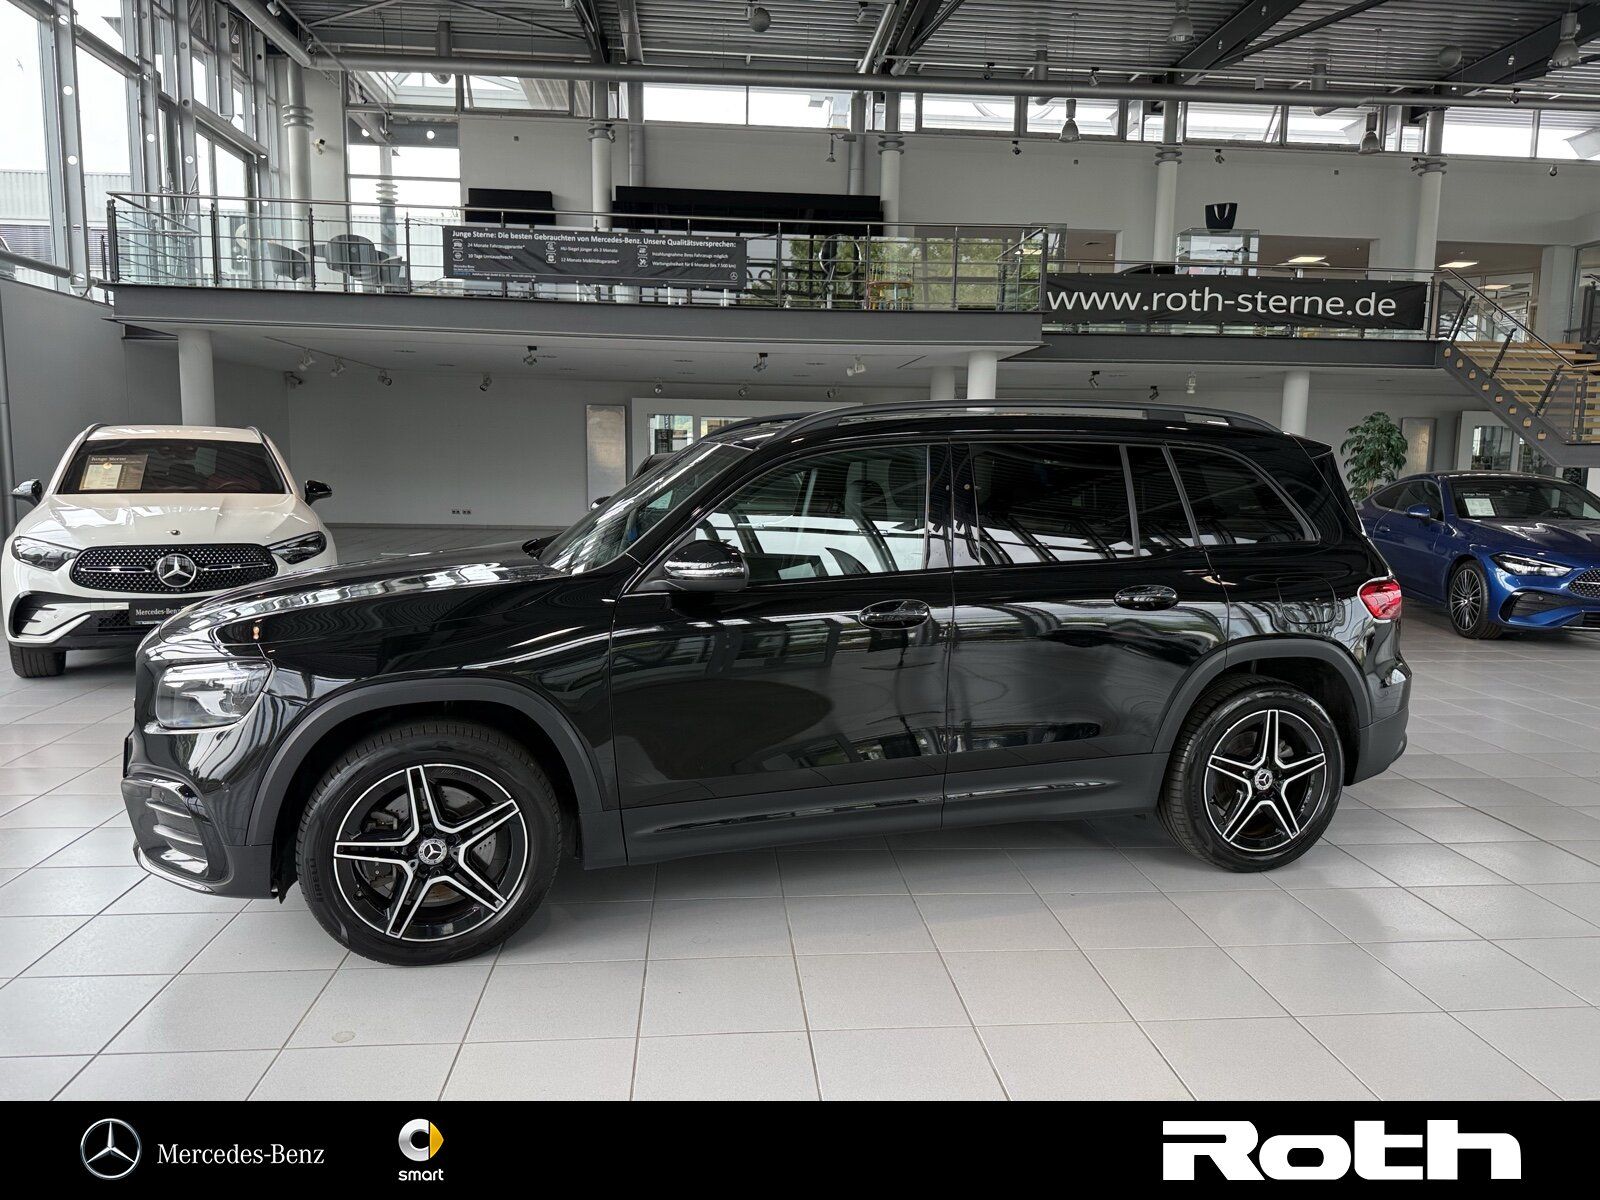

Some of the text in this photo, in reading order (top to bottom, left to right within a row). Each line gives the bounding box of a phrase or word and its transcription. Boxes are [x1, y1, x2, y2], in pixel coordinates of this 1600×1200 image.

[452, 230, 472, 239] Junge
[472, 230, 497, 239] Sterne:
[497, 231, 509, 239] Die
[510, 232, 533, 240] besten
[533, 233, 576, 242] Gebrauchten
[590, 236, 642, 244] Mercedes-Benz.
[643, 238, 666, 246] Unsere
[667, 238, 737, 248] Qualitätsversprechen:
[1046, 286, 1397, 317] www.roth-sterne.de
